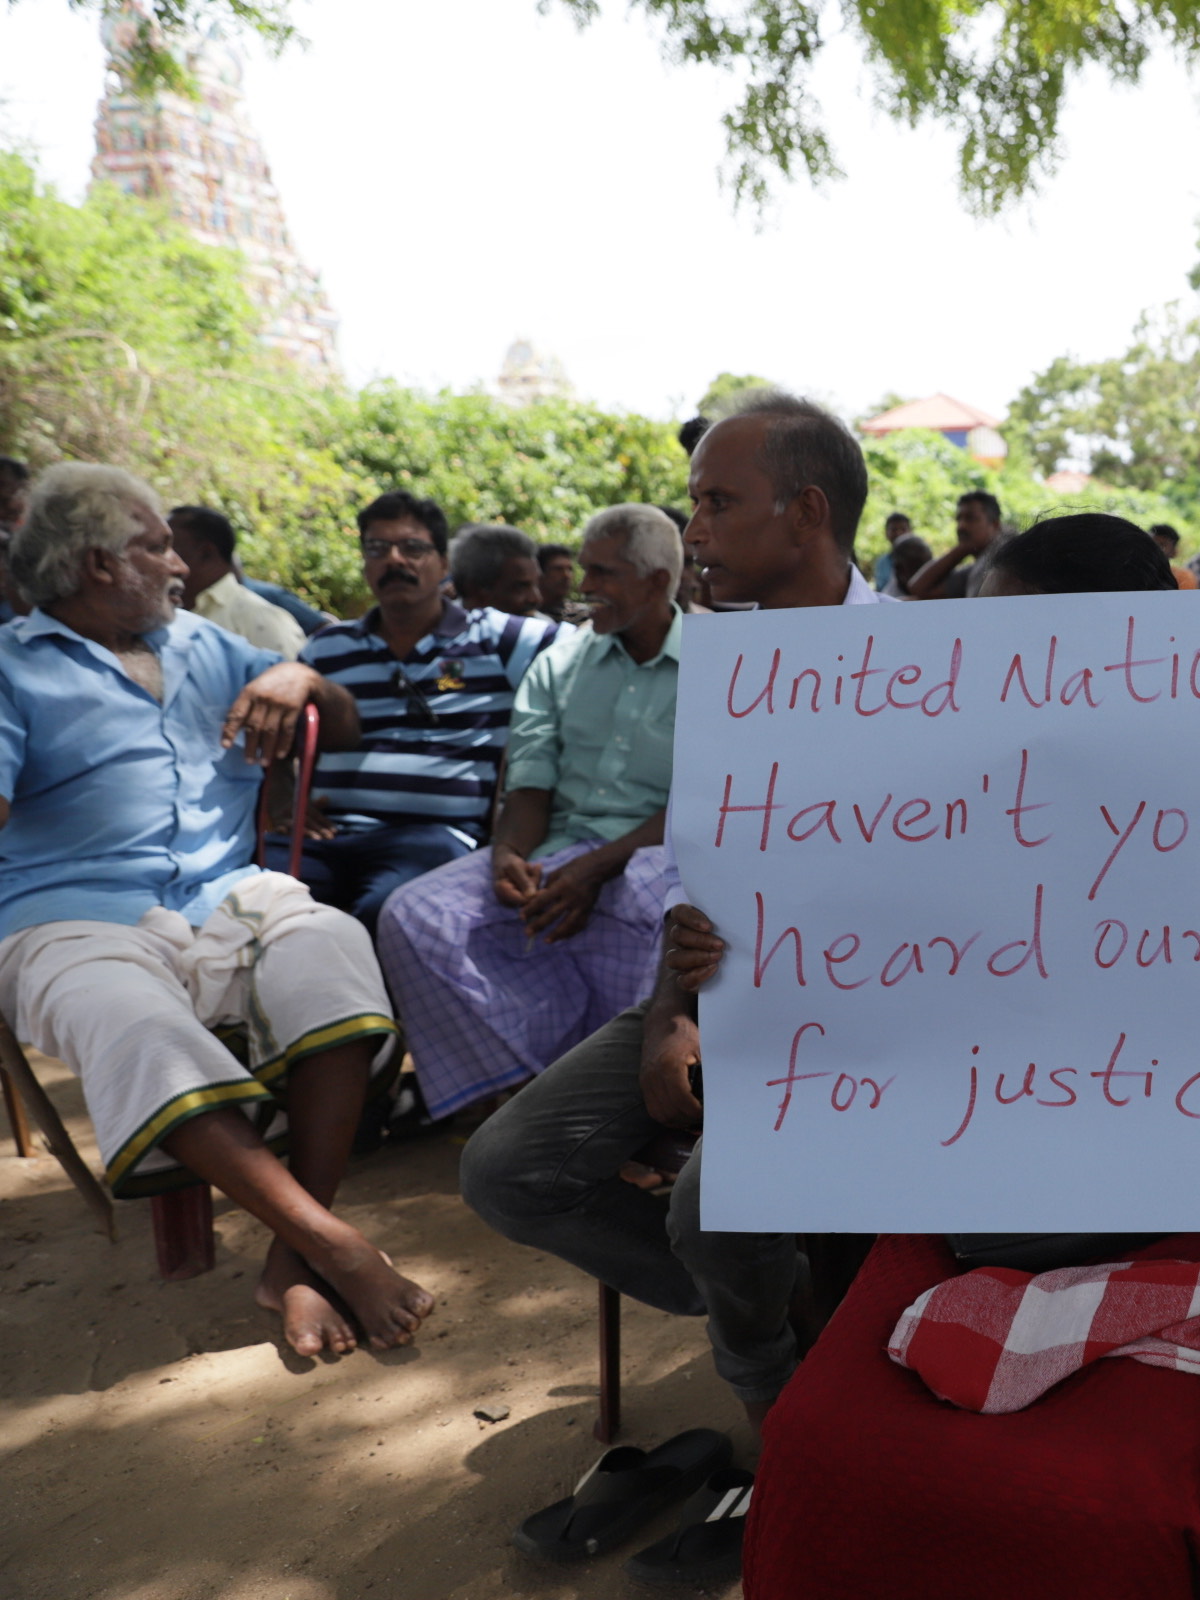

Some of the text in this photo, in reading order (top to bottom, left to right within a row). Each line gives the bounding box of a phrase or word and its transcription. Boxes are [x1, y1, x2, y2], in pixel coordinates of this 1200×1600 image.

[727, 636, 962, 718] United
[713, 748, 1052, 852] Haven't
[753, 884, 1049, 990] heard
[765, 1021, 895, 1132] for
